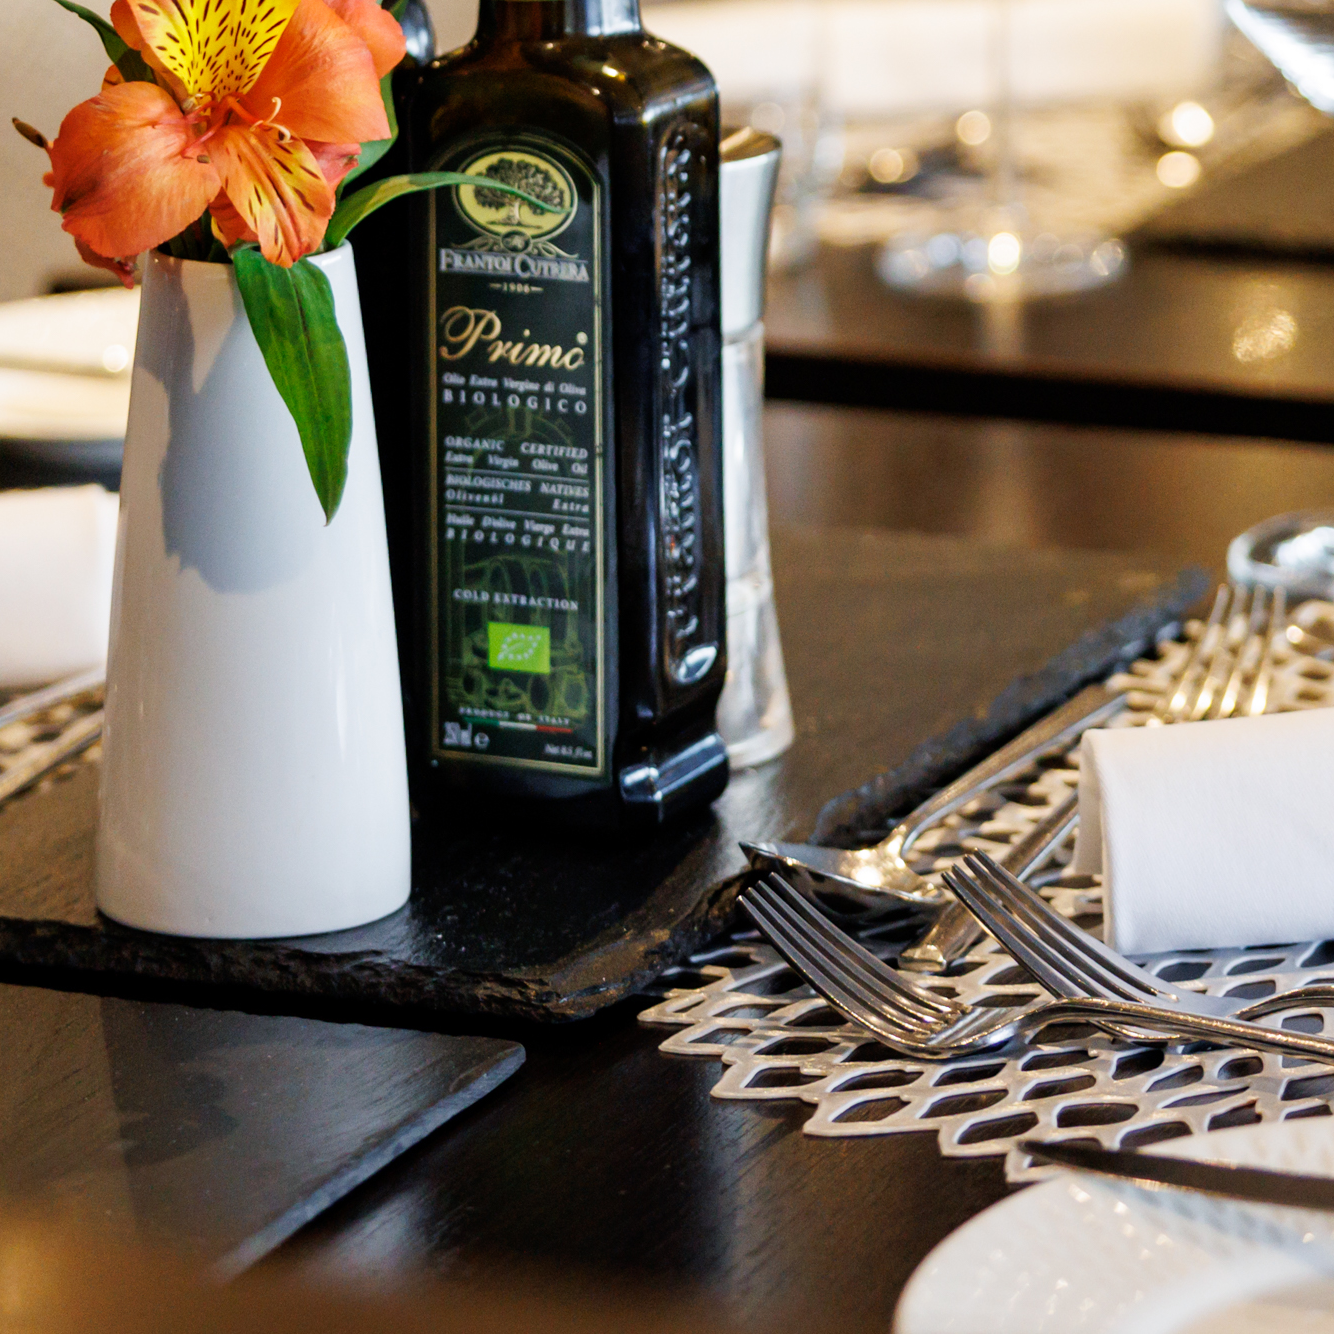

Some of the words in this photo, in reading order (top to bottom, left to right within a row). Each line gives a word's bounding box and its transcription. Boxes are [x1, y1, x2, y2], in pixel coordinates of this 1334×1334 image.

[440, 248, 511, 274] FRANTOI
[515, 254, 589, 282] CUTRERA
[444, 435, 505, 452] ORGANIC
[520, 442, 589, 460] CERTIFIED
[488, 454, 519, 470] Virgin
[531, 457, 559, 472] Olive
[446, 473, 532, 493] BIOLOGISCHES
[540, 481, 589, 499] NATIVES
[553, 498, 589, 513] Extra
[453, 588, 489, 603] COLD
[493, 591, 578, 611] EXTRACTION
